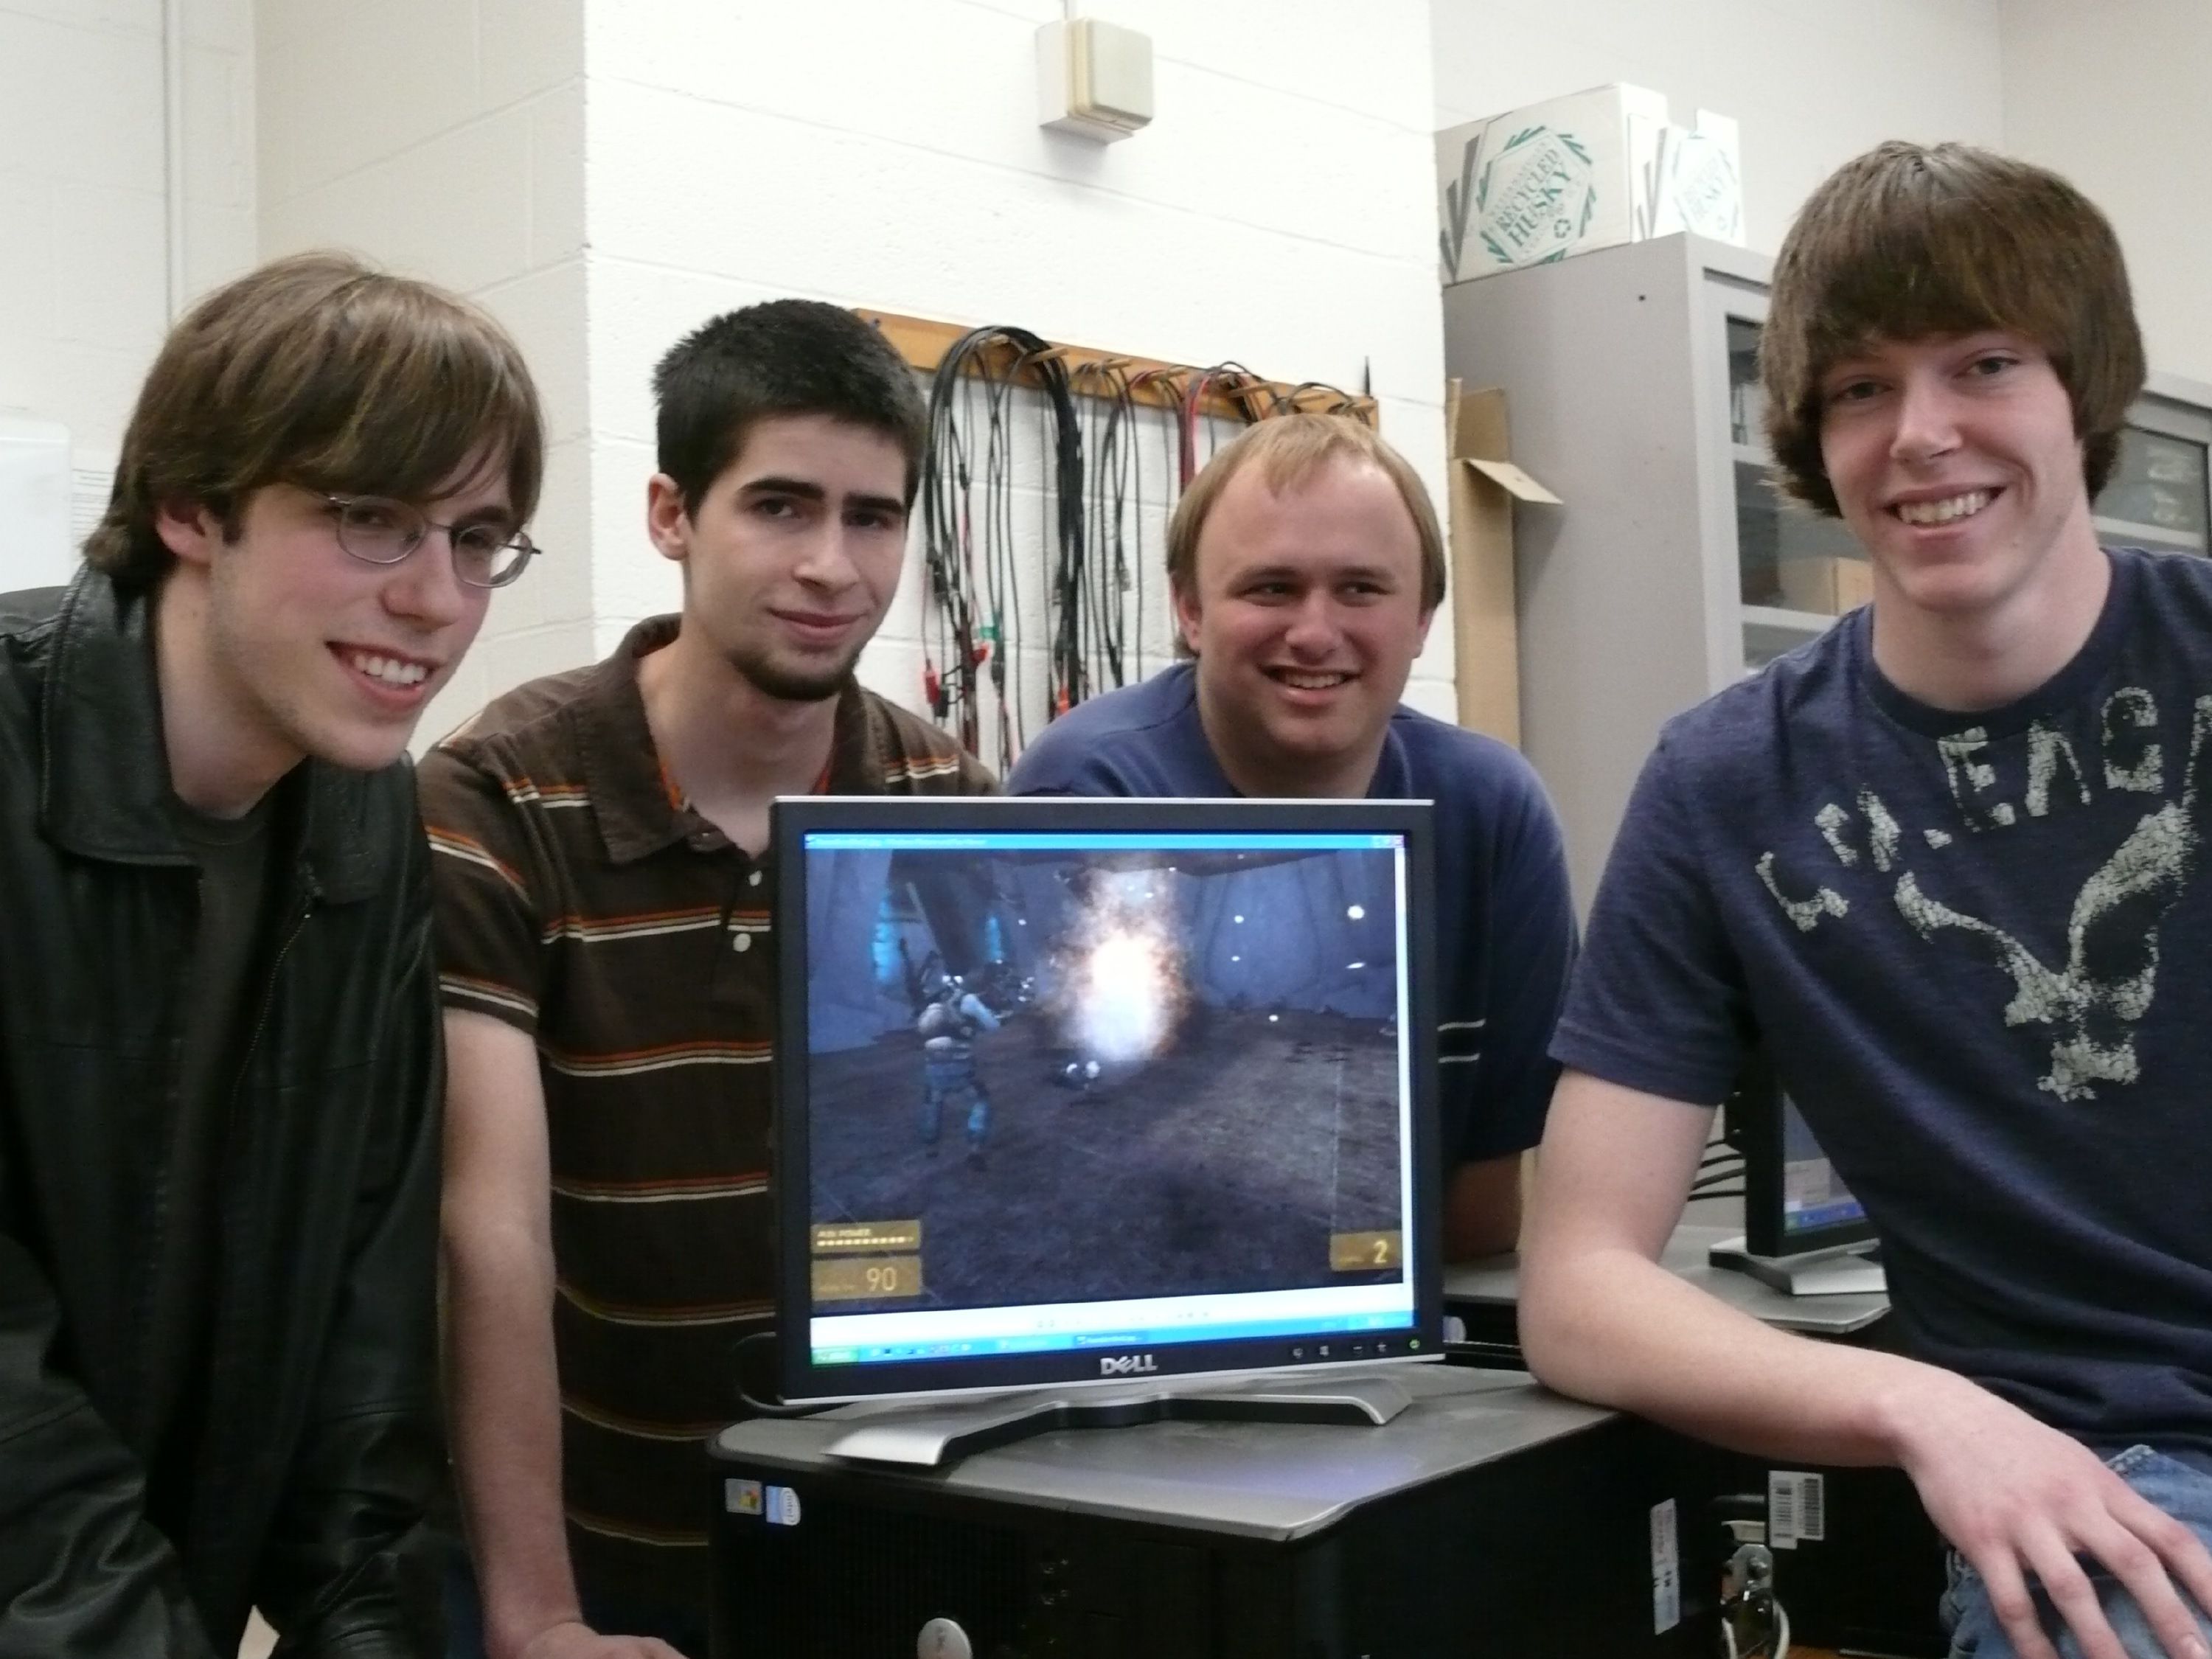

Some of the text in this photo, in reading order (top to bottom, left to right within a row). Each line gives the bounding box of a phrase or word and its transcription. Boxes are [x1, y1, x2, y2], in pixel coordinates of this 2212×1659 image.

[1495, 149, 1559, 232] RECYCLED
[1507, 161, 1572, 247] HUSKY
[1373, 1240, 1388, 1264] 2
[866, 1267, 897, 1291] 90
[1100, 1354, 1158, 1375] DELL
